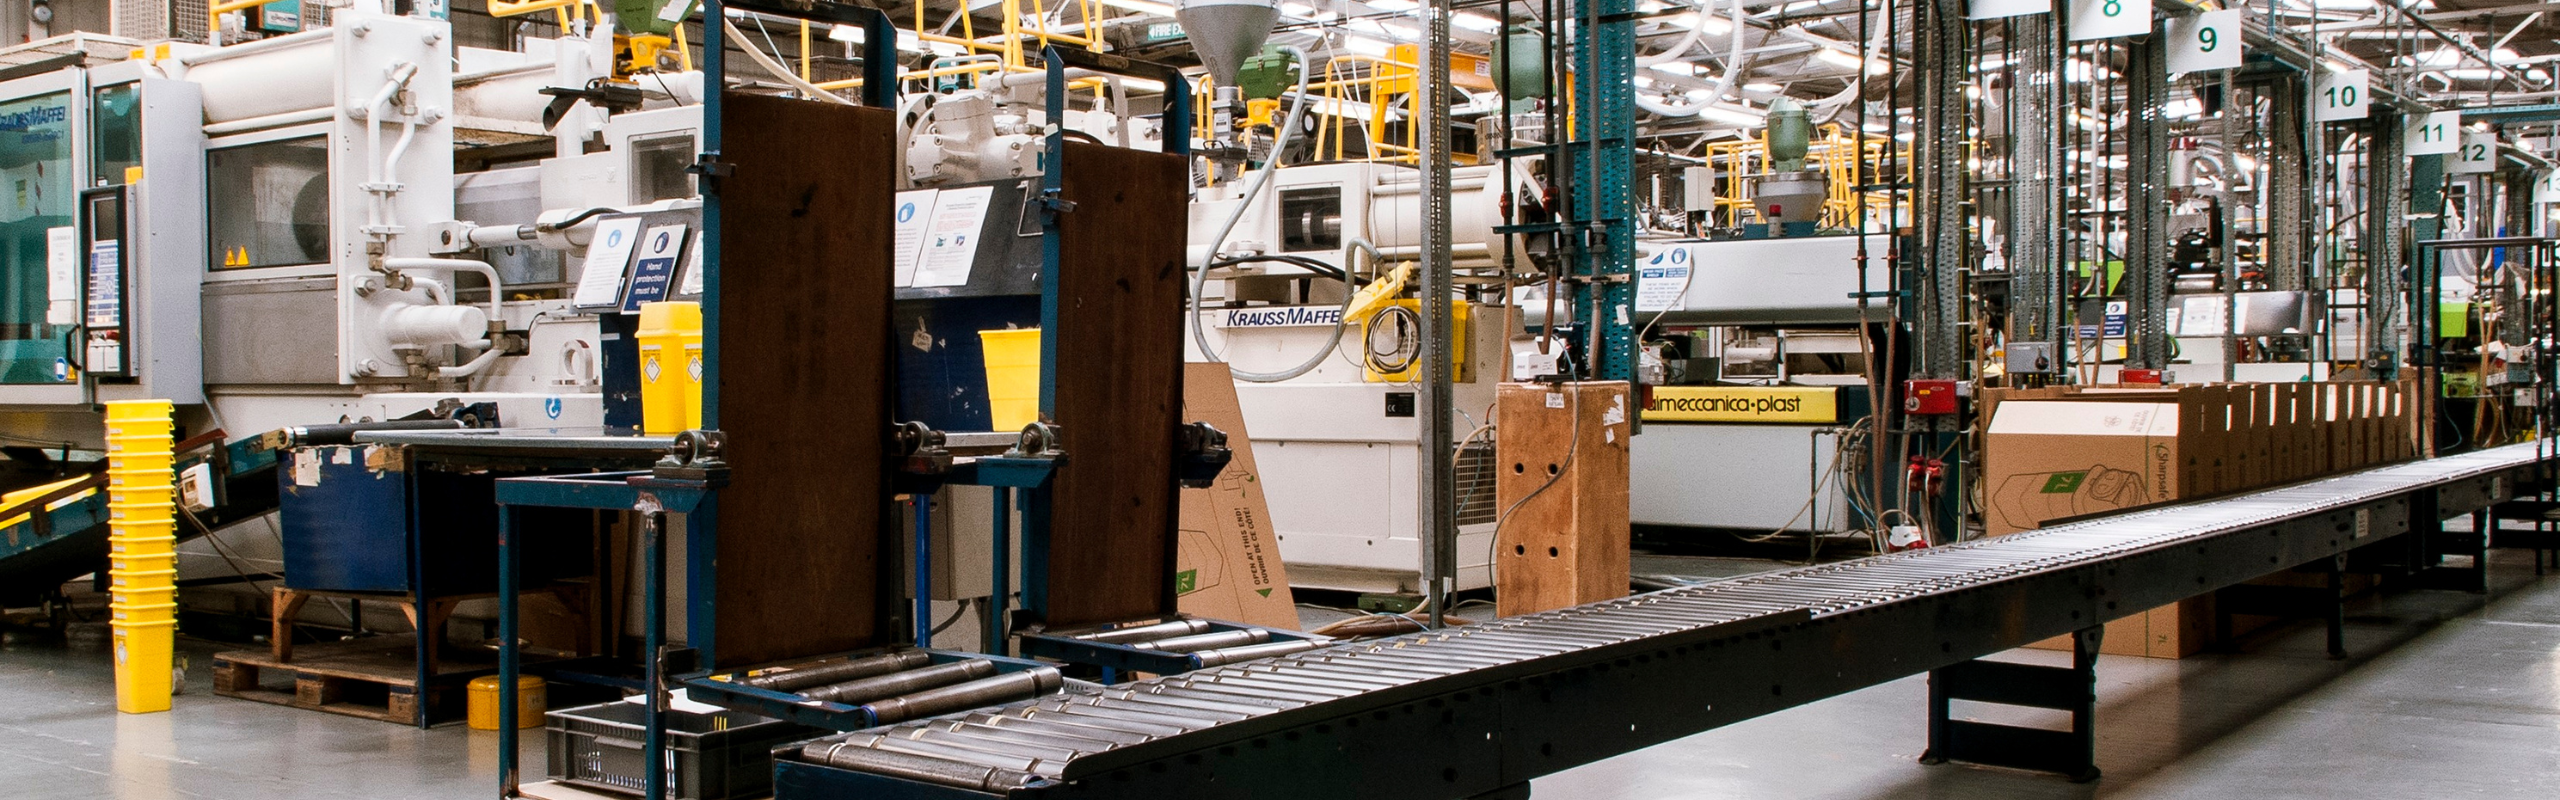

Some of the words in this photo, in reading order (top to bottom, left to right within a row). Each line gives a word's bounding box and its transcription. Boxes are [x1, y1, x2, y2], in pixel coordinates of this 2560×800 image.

[2103, 0, 2121, 17] 8
[2199, 27, 2217, 52] 9
[2324, 85, 2356, 109] 10
[2419, 123, 2443, 143] 11
[2460, 144, 2486, 162] 12
[646, 262, 663, 271] Hand
[635, 275, 666, 285] protection
[634, 287, 651, 295] must
[651, 286, 660, 295] be
[1227, 308, 1341, 326] KRAUSSMAFFE
[2053, 476, 2074, 490] 7L
[1234, 507, 1245, 528] END!
[1240, 530, 1251, 550] THIS
[1250, 530, 1258, 541] CE
[1246, 551, 1254, 561] AT
[1253, 543, 1261, 554] DE
[1250, 563, 1261, 586] OPEN
[1256, 555, 1269, 585] OUVRIR
[1180, 573, 1190, 590] 7L
